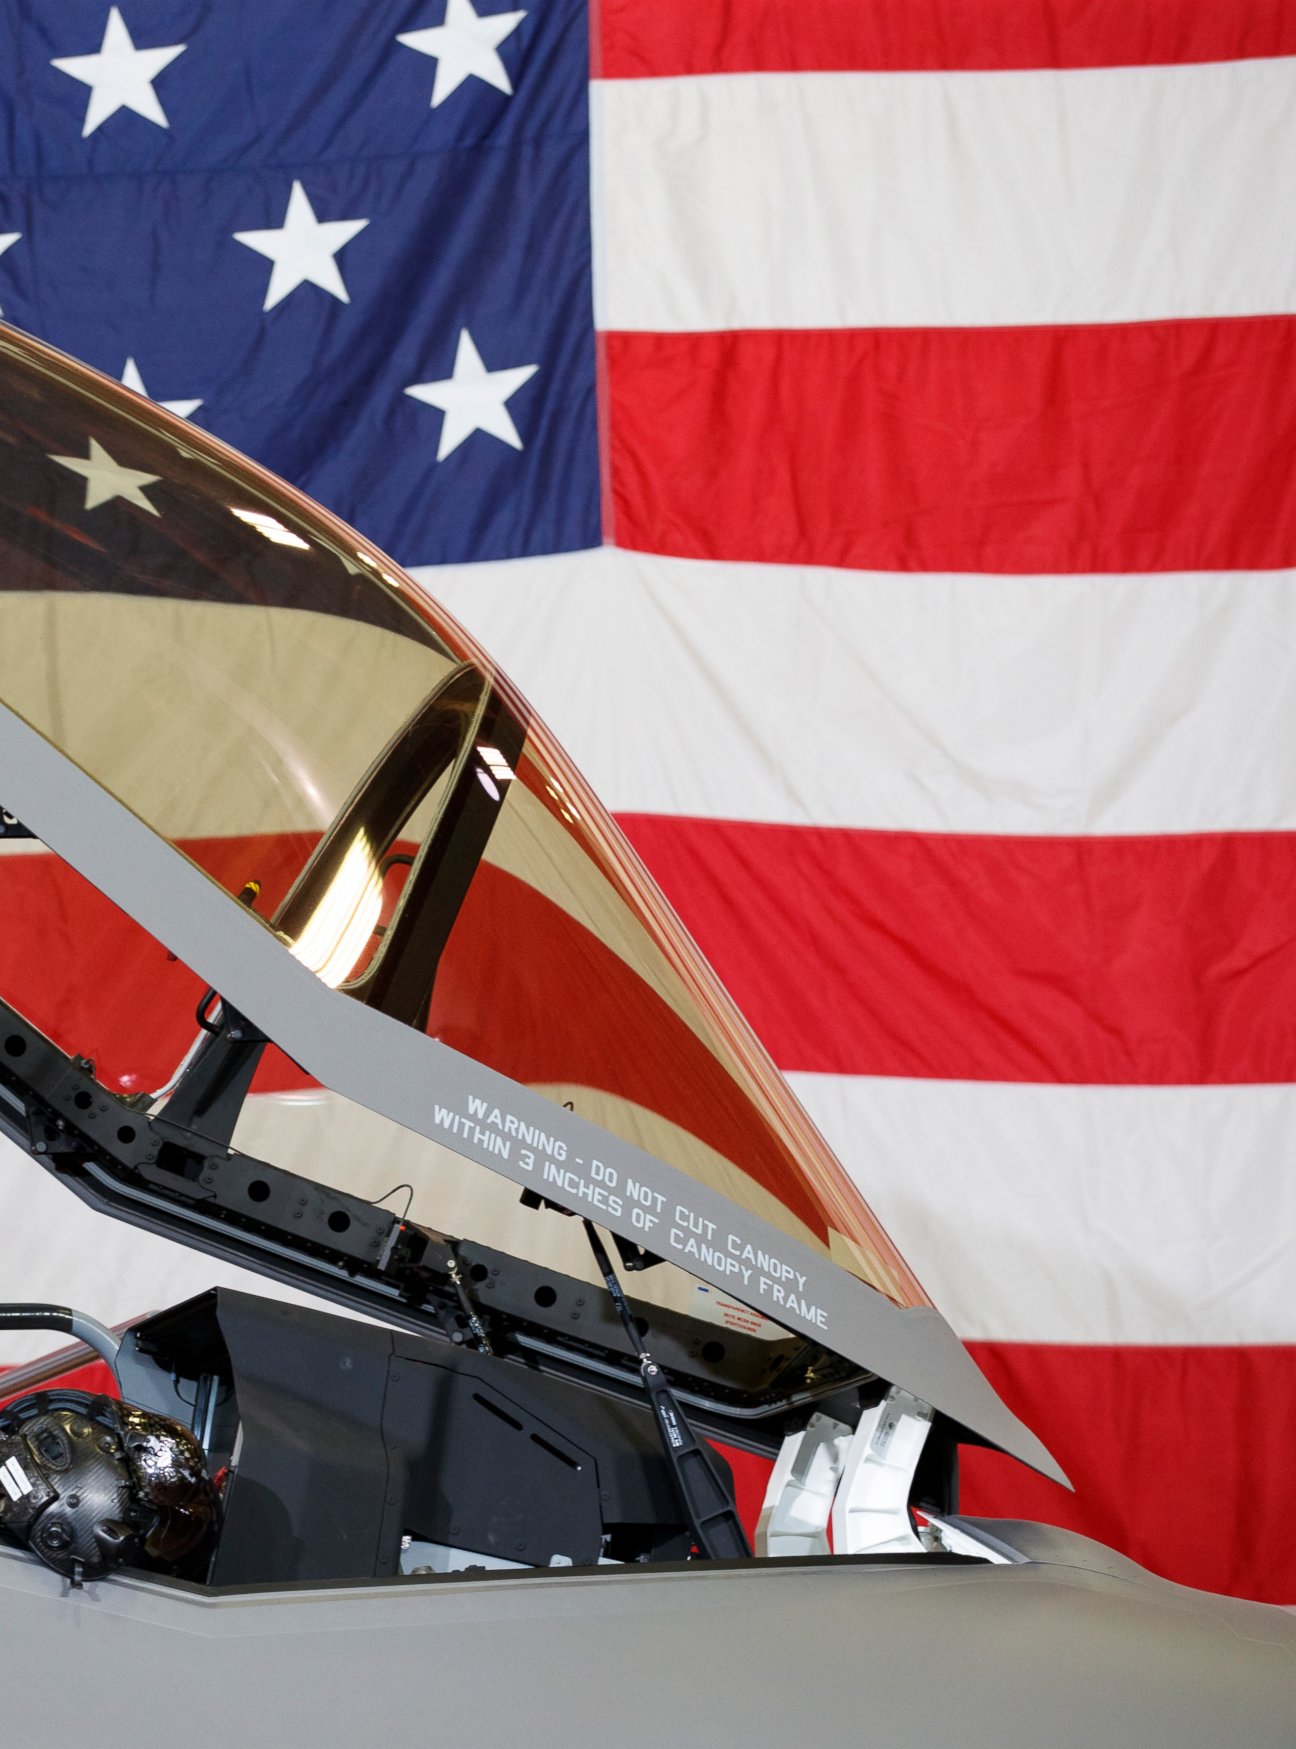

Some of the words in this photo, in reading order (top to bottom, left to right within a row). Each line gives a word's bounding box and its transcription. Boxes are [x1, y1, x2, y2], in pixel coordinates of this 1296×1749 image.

[434, 1104, 511, 1160] WITHIN
[519, 1150, 535, 1171] 3
[542, 1161, 623, 1217] INCHES
[632, 1208, 660, 1232] OF
[670, 1228, 752, 1286] CANOPY
[760, 1277, 829, 1330] FRAME
[468, 1094, 568, 1161] WARNING
[591, 1160, 618, 1188] DO
[626, 1178, 667, 1213] NOT
[675, 1206, 717, 1241] CUT
[728, 1235, 807, 1292] CANOPY
